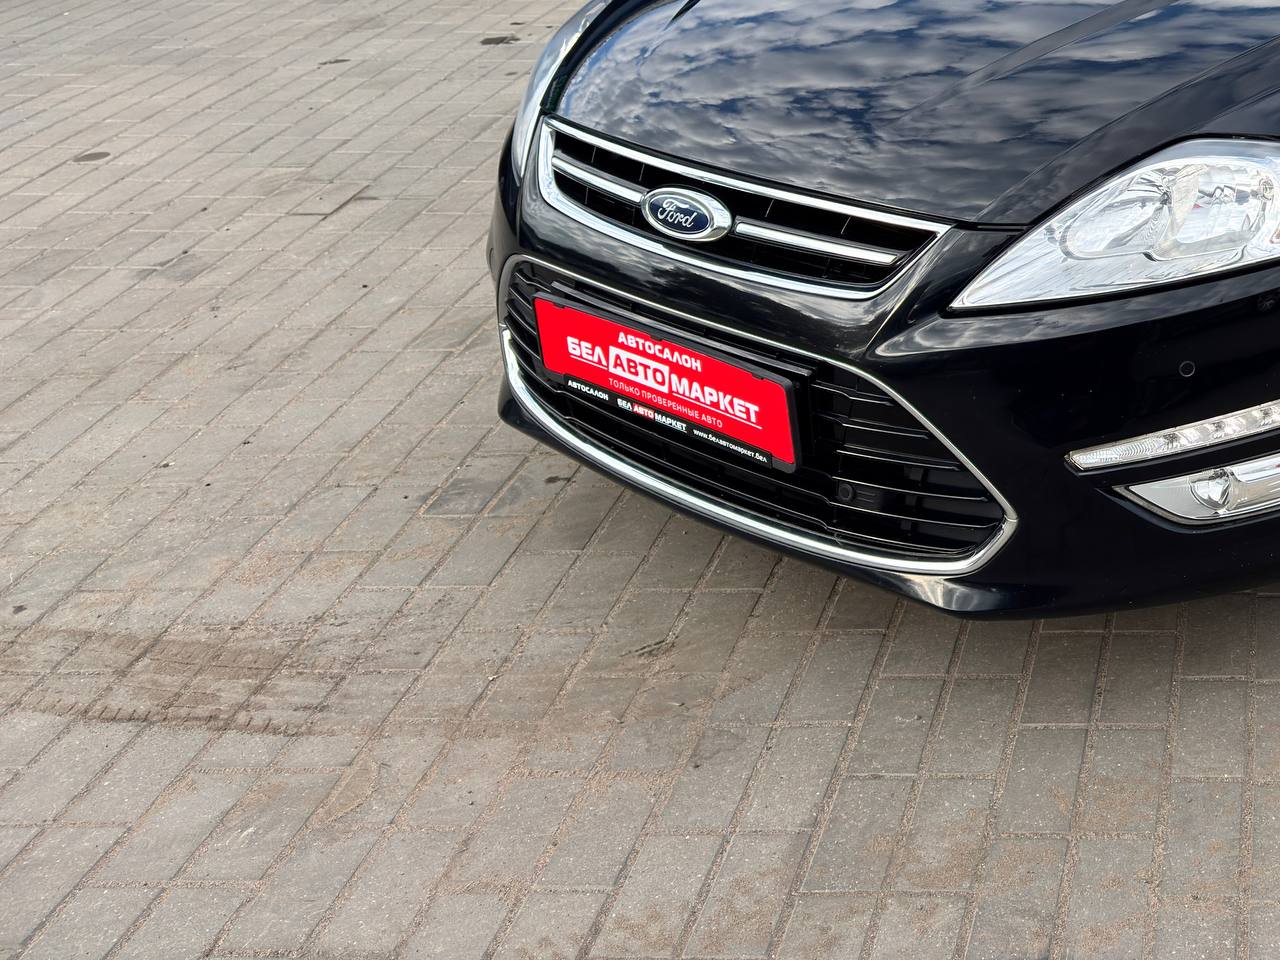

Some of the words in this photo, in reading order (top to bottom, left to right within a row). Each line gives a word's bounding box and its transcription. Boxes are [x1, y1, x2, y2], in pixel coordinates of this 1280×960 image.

[657, 198, 698, 228] Ford
[617, 331, 702, 372] АВТОСАЛОН
[566, 335, 607, 367] БЕЛ
[612, 356, 667, 387] АВТО
[671, 373, 760, 423] МАРКЕТ
[608, 378, 640, 396] ТОЛЬКО
[641, 390, 700, 419] ПРОВЕРЕННЫЕ
[701, 413, 723, 428] АВТО
[567, 379, 609, 401] АВТОСАЛОН
[617, 398, 632, 410] БЕЛ
[633, 405, 654, 418] АВТО
[654, 412, 687, 431] МАРКЕТ
